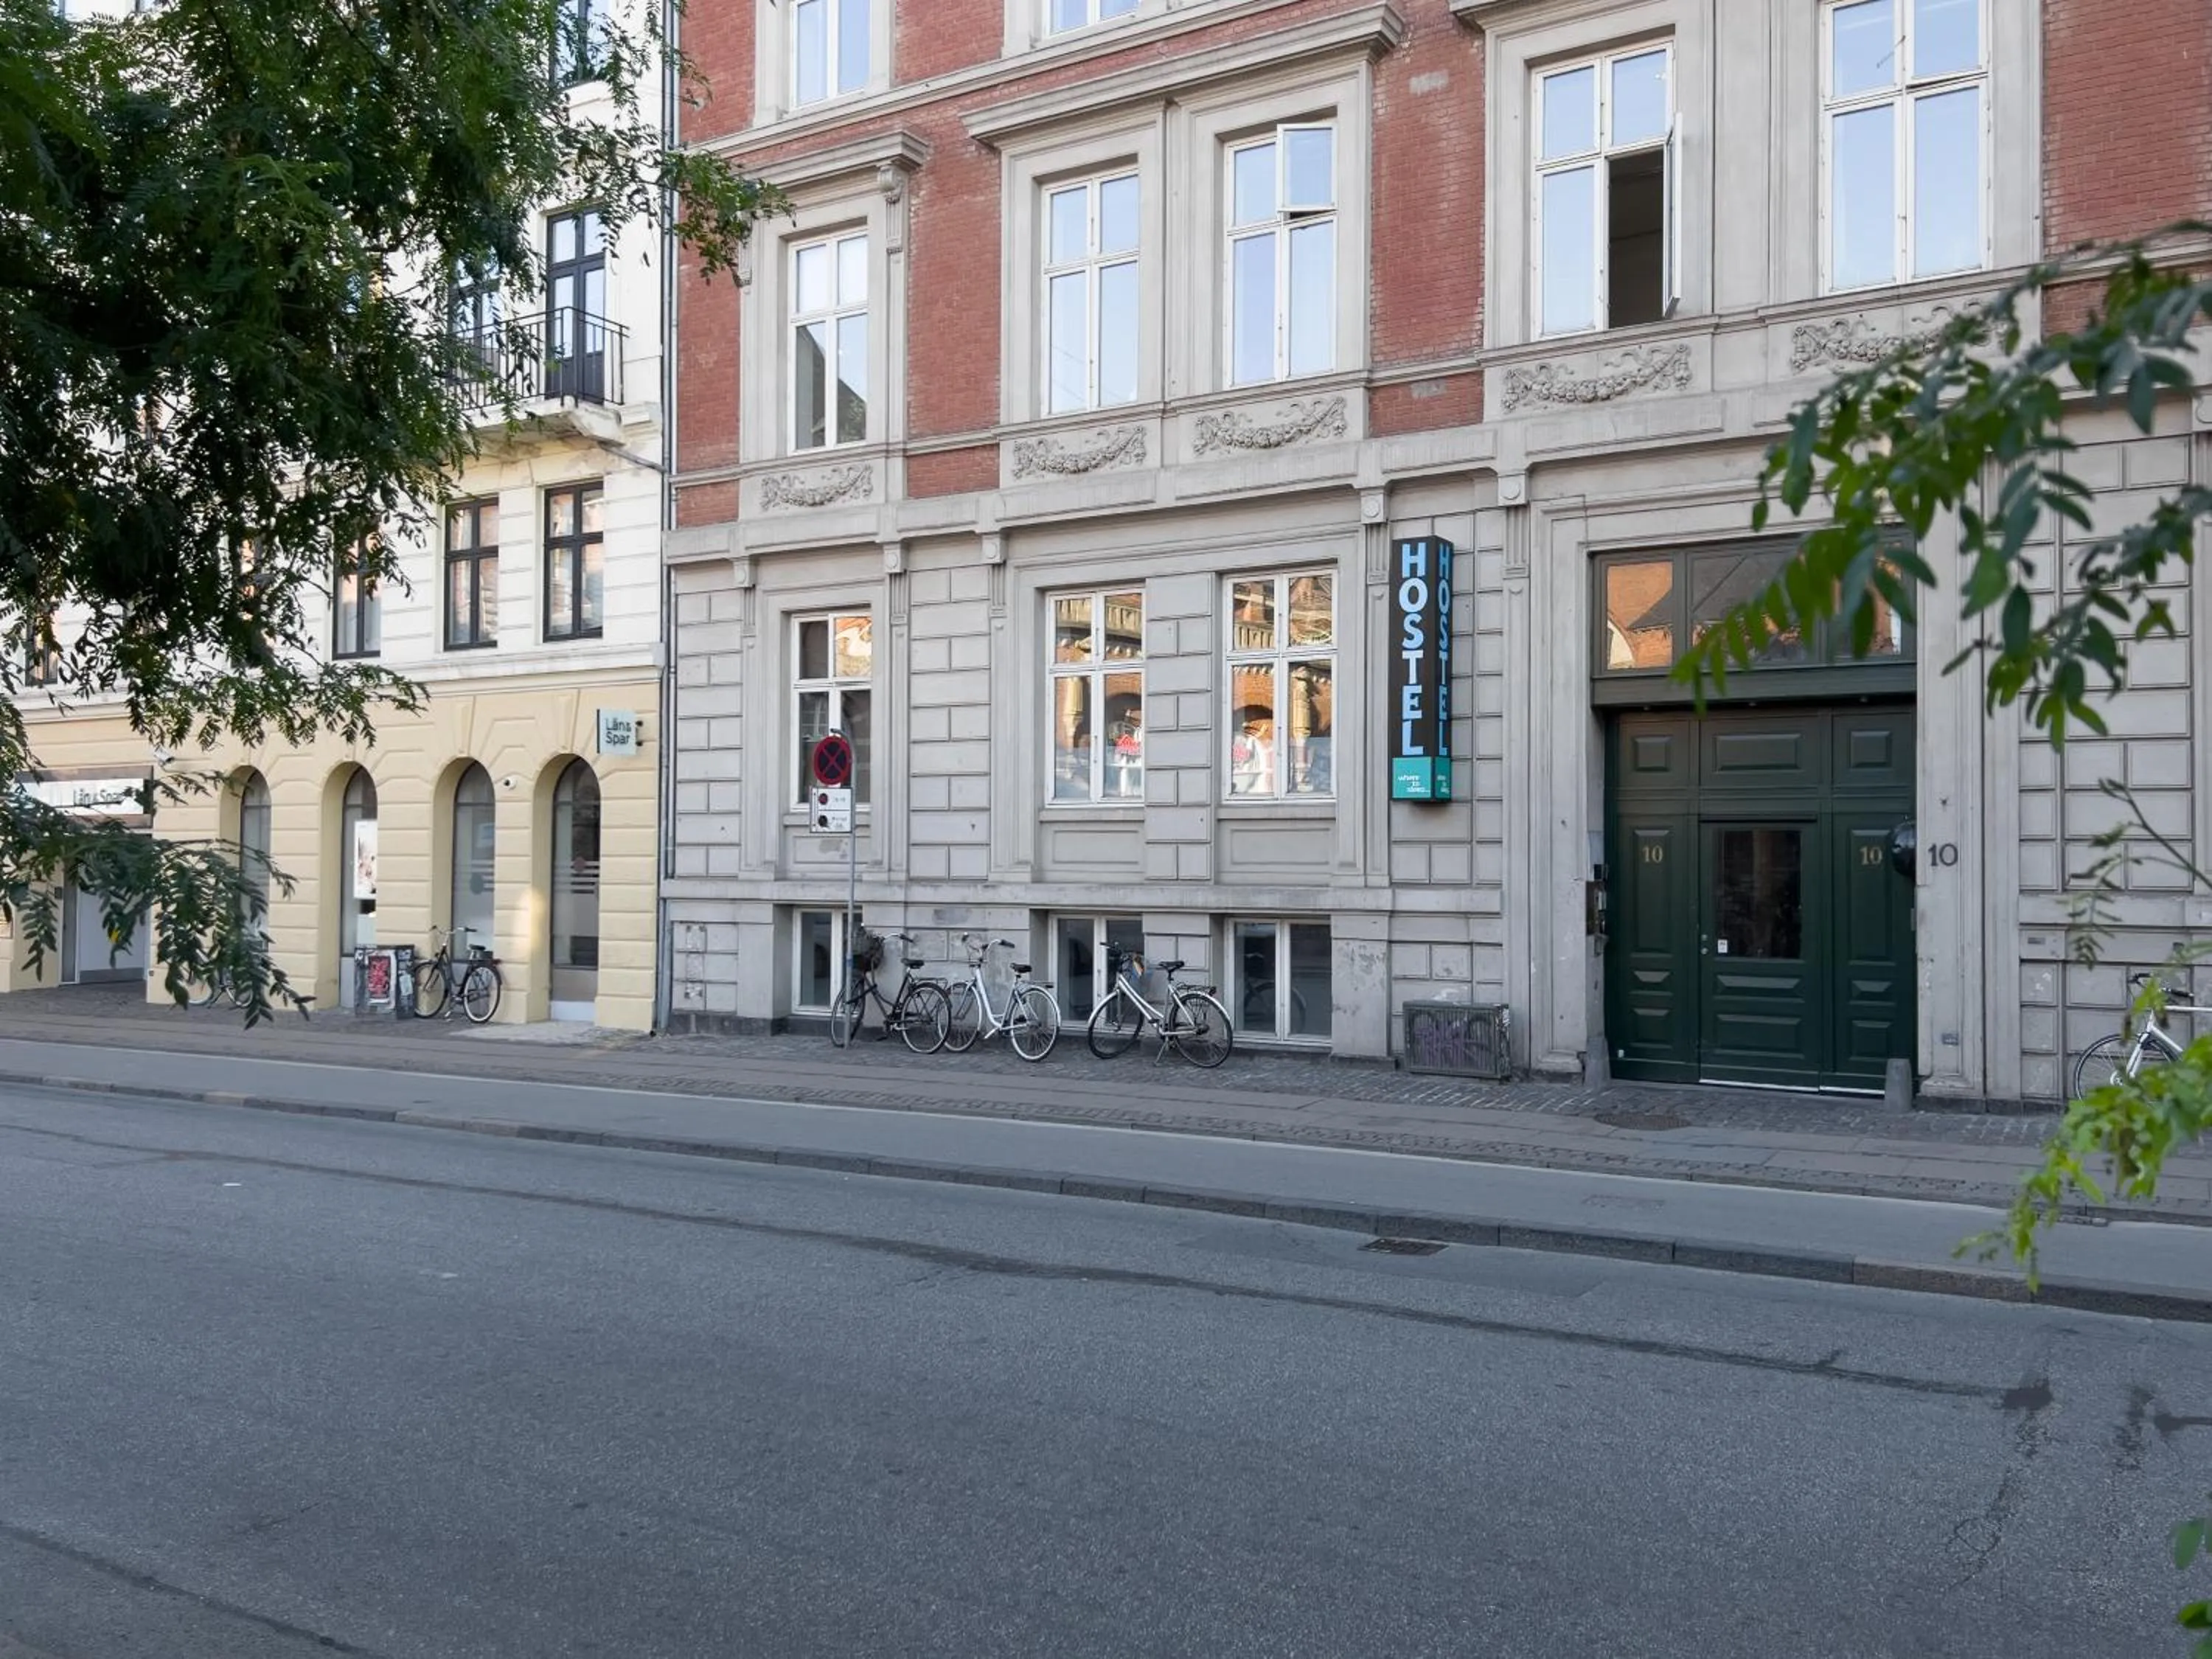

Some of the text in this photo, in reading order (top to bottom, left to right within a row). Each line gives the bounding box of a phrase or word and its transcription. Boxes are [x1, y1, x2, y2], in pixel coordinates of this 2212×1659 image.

[1399, 542, 1427, 756] HOSTEL
[1438, 542, 1450, 756] HOSTEL
[605, 731, 630, 746] Spar
[1642, 845, 1663, 863] 10
[1860, 846, 1883, 865] 10
[1928, 843, 1958, 866] 10
